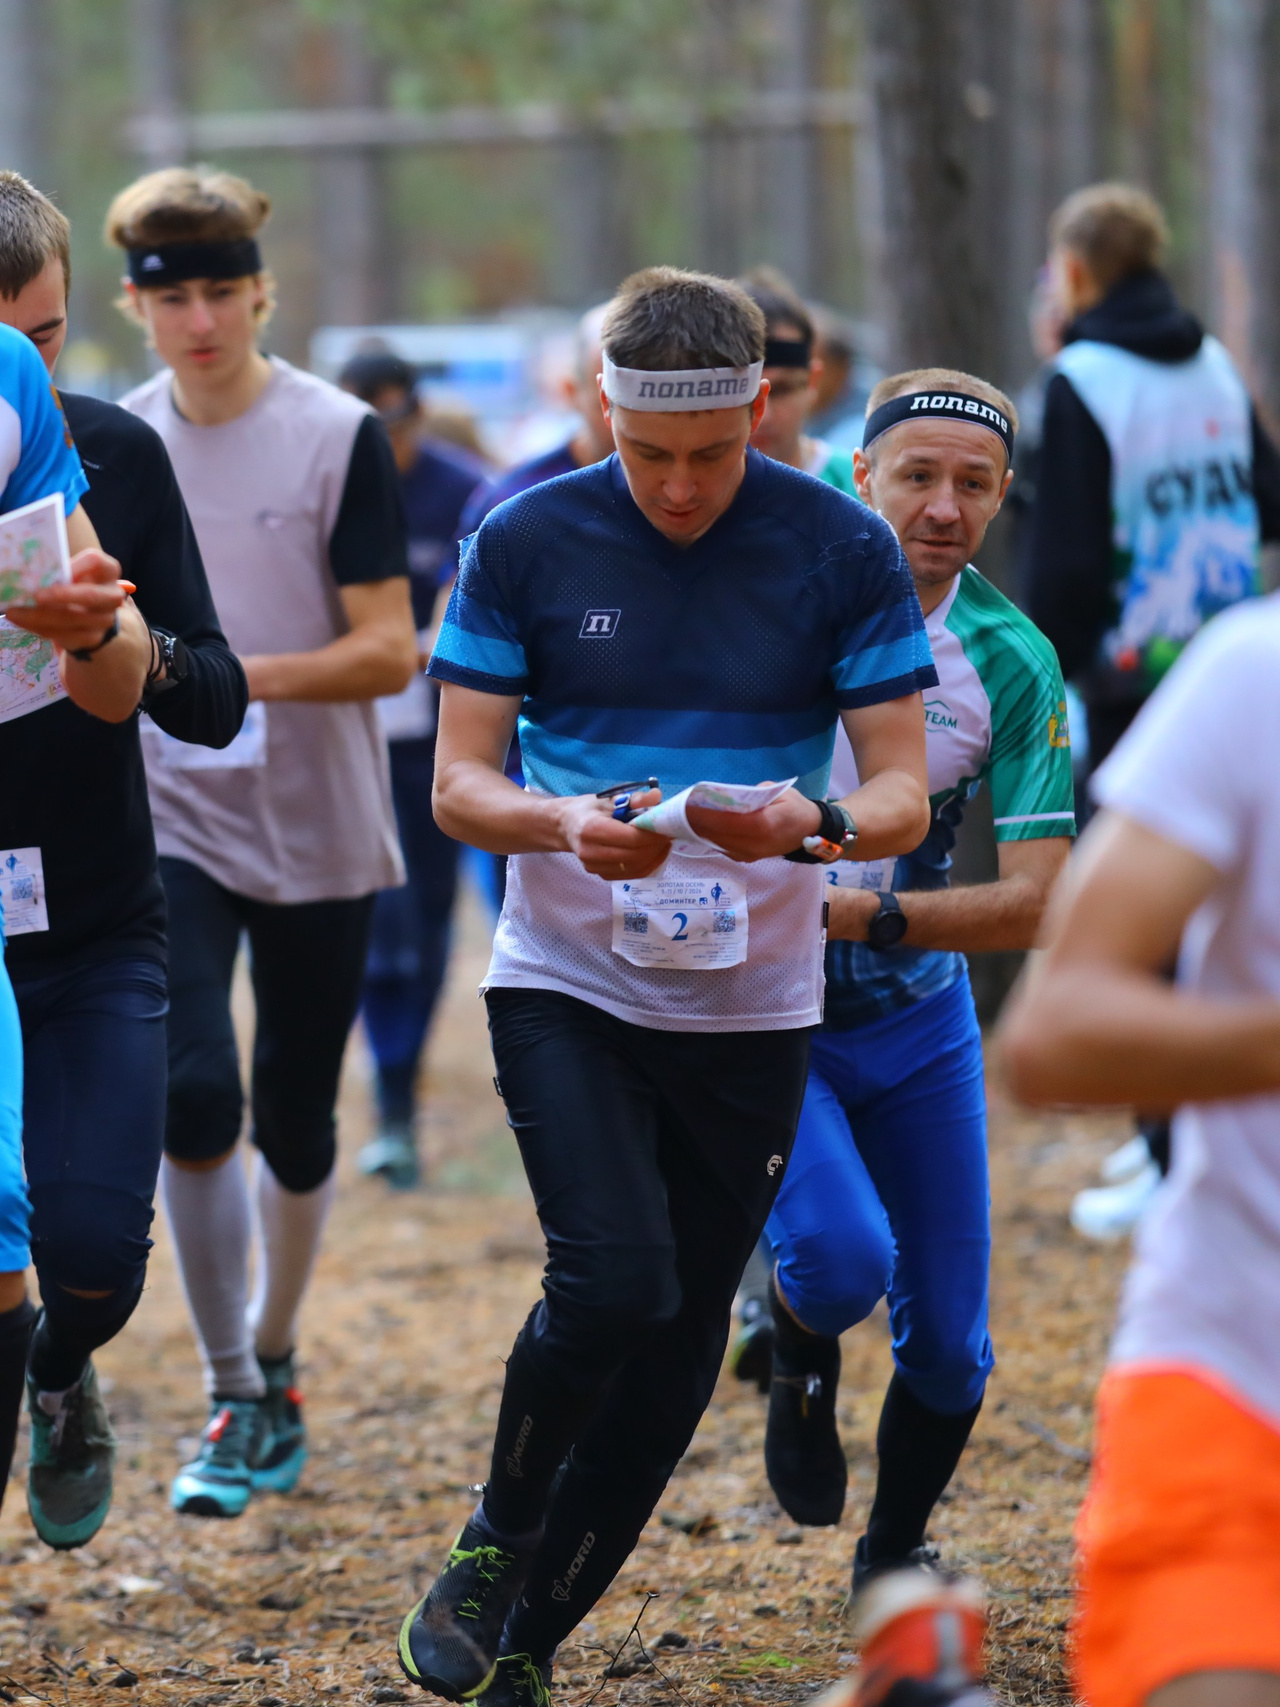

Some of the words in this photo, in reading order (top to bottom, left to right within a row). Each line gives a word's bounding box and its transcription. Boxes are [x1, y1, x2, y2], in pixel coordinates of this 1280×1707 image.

[637, 377, 750, 399] noname
[910, 395, 1009, 434] noname
[925, 711, 958, 729] TEAM
[671, 912, 688, 941] 2
[564, 1531, 596, 1587] NORD
